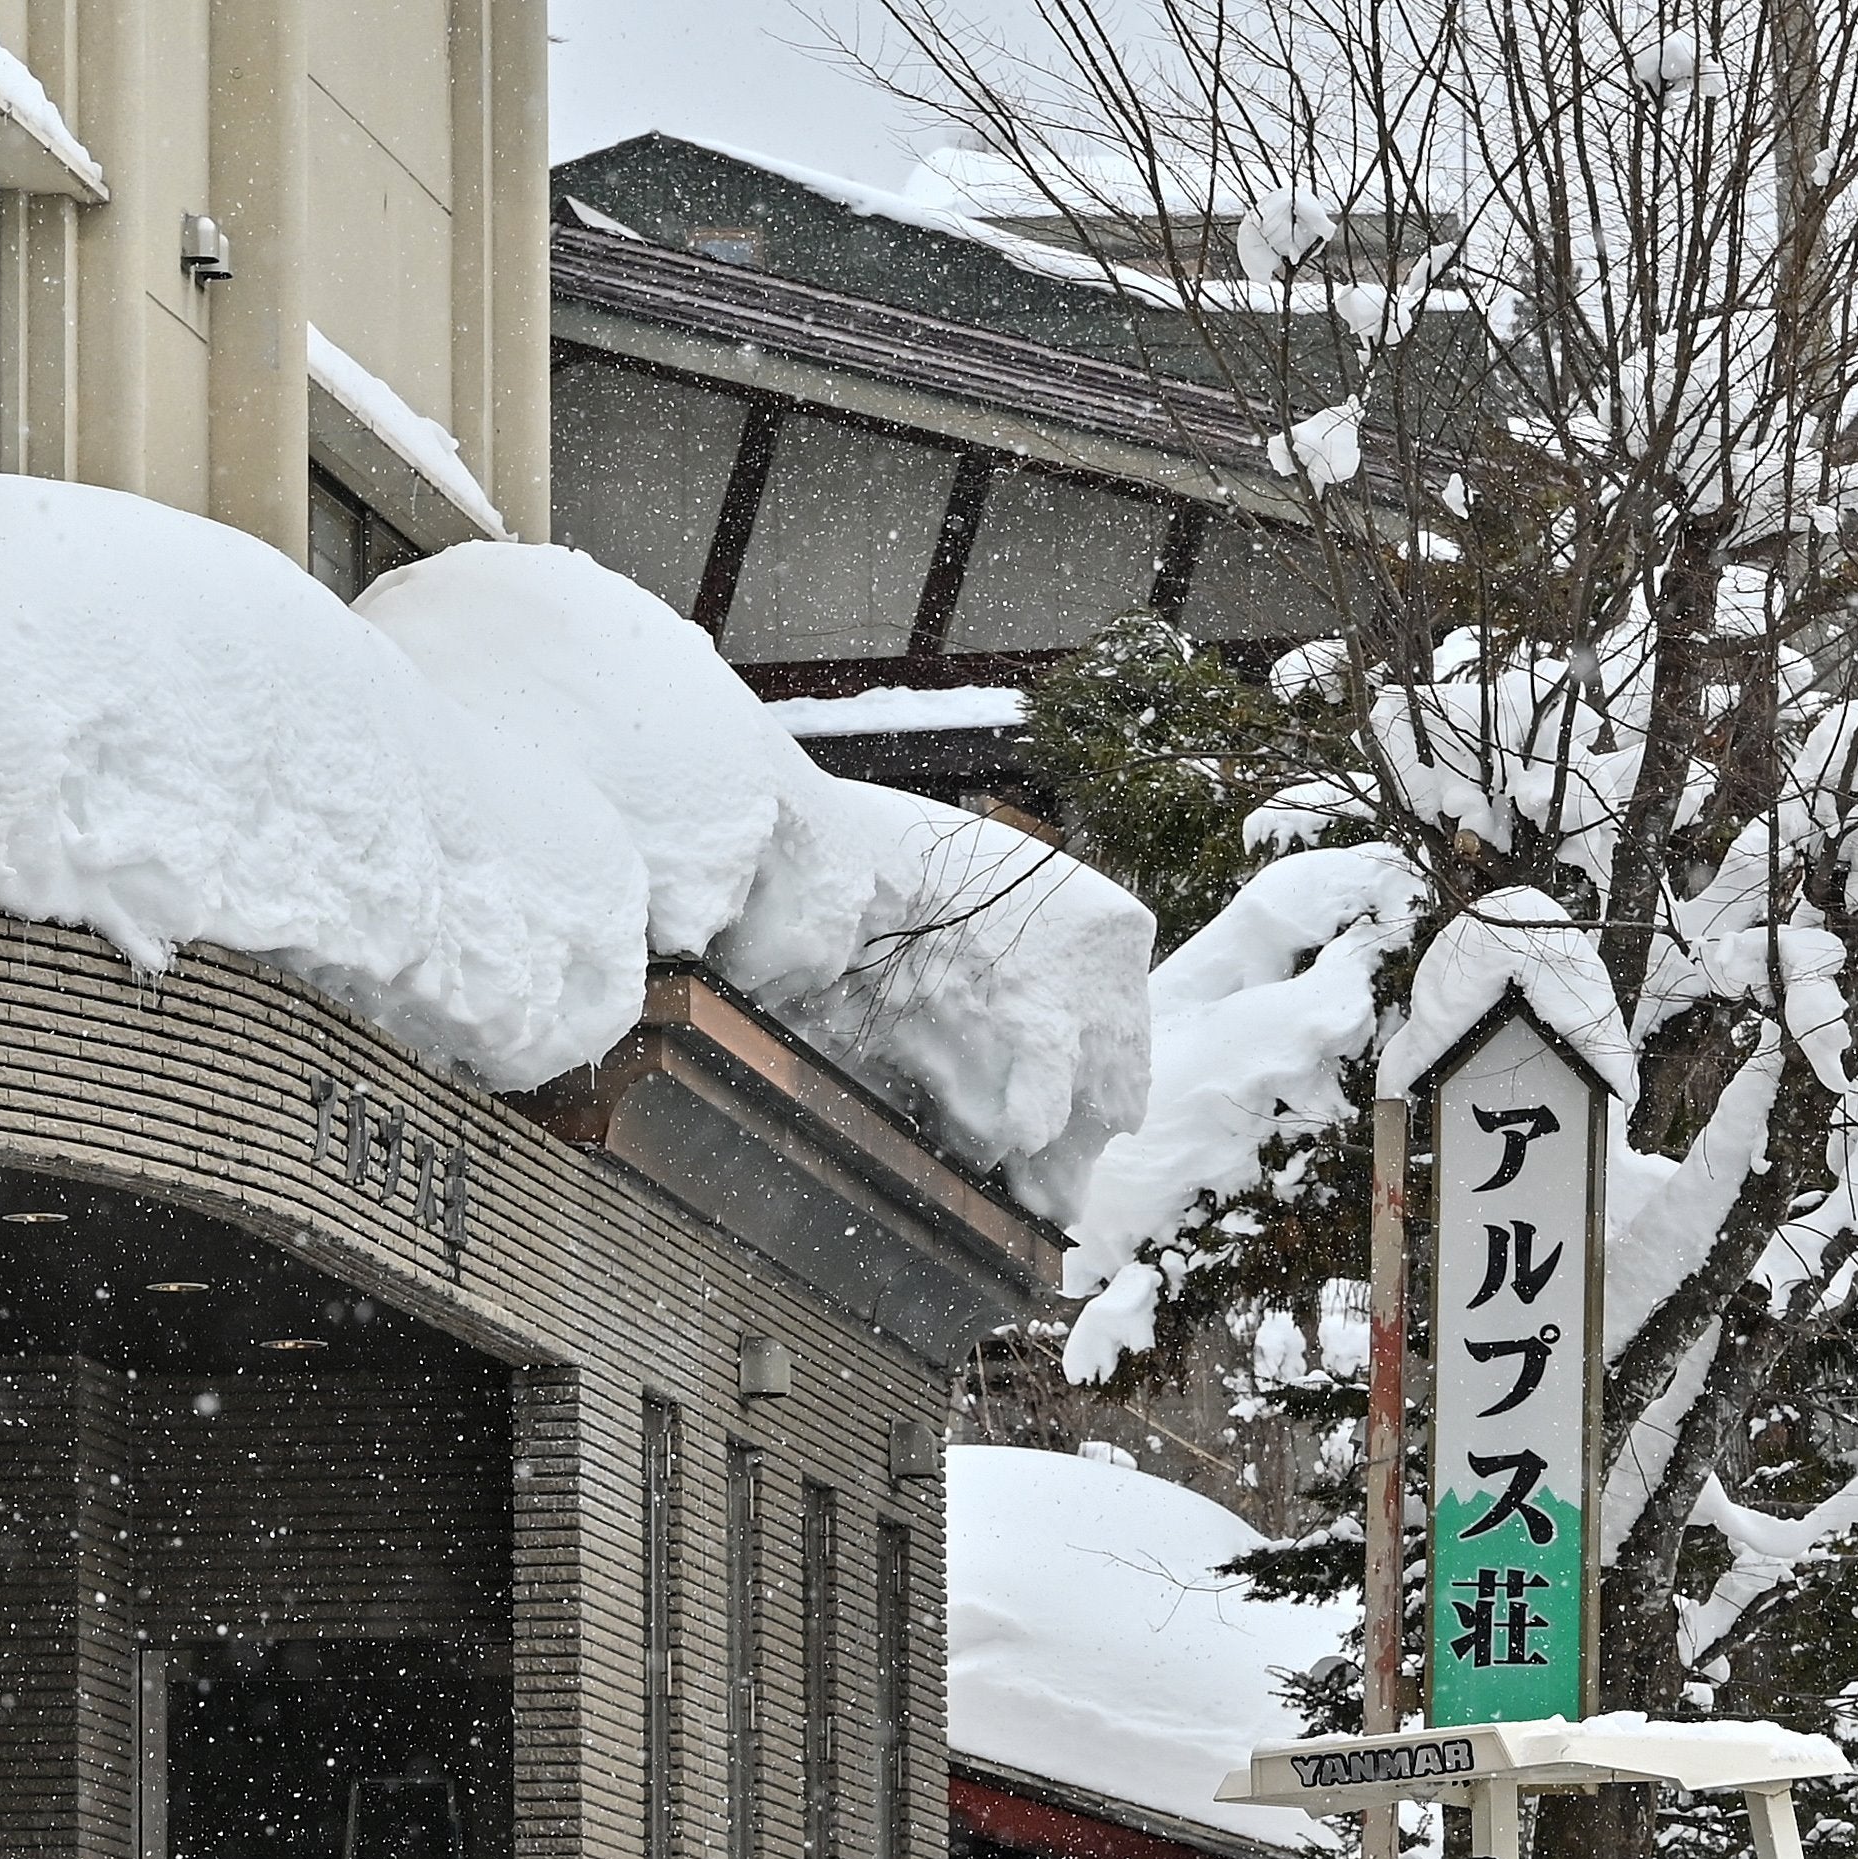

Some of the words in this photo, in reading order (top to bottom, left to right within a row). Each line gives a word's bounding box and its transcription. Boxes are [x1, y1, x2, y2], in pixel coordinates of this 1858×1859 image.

[1449, 1102, 1564, 1669] アルプス荘
[1291, 1739, 1474, 1788] YANMAR
